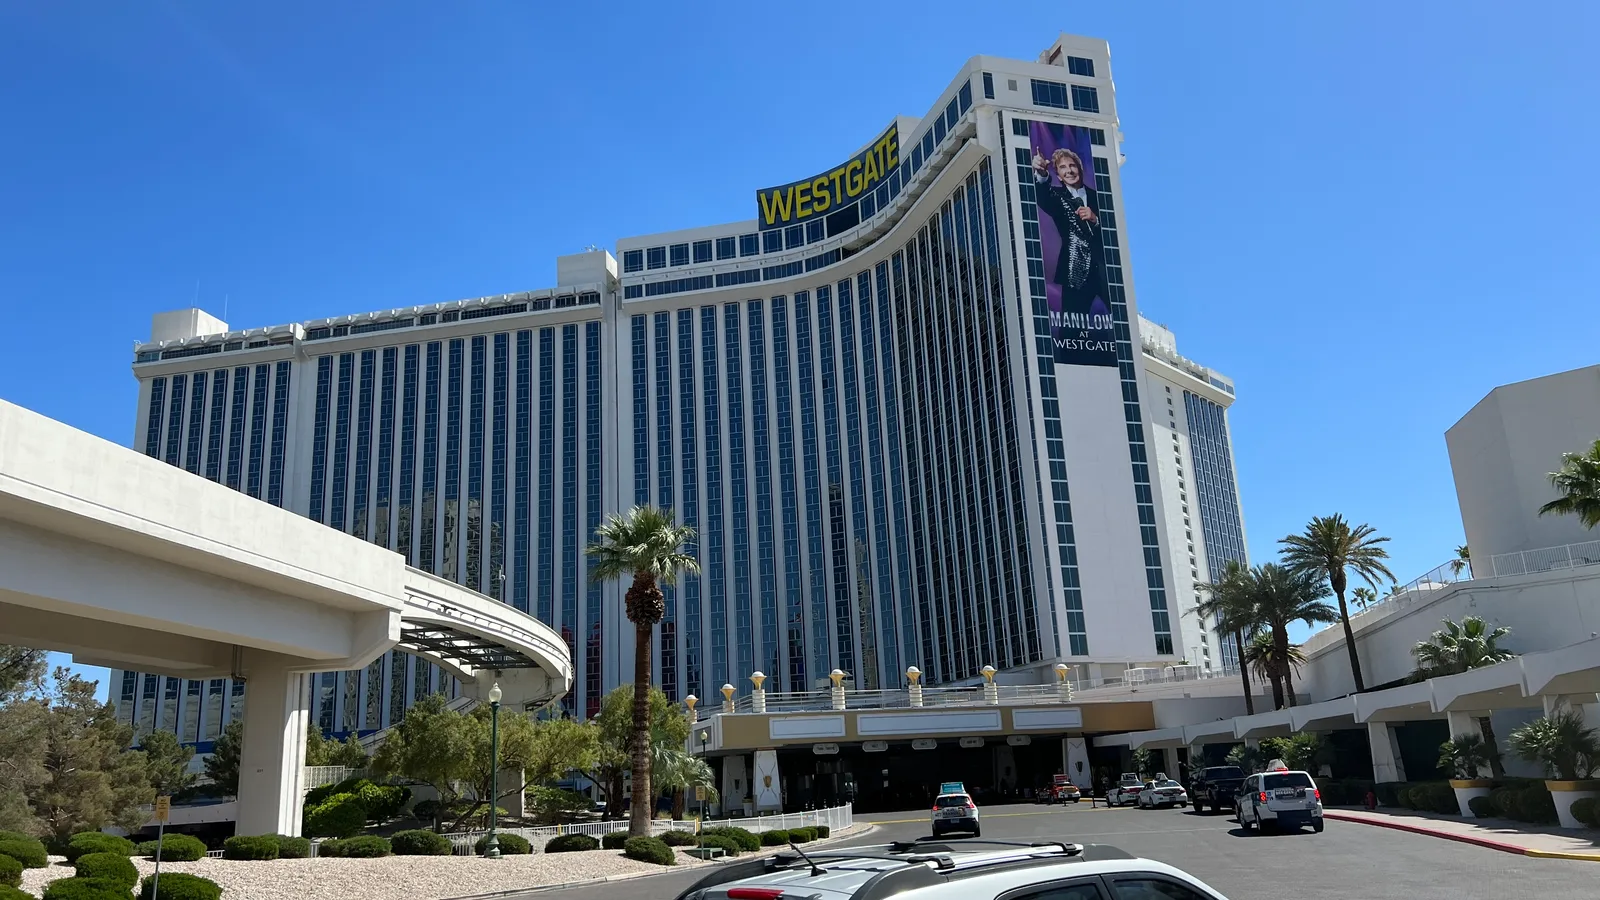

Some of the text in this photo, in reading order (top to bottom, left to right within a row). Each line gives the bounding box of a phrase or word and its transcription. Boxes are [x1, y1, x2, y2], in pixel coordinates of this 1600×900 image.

[760, 127, 898, 225] WESTGATE
[1050, 311, 1113, 330] MANILOW
[1053, 338, 1116, 352] WESTGATE
